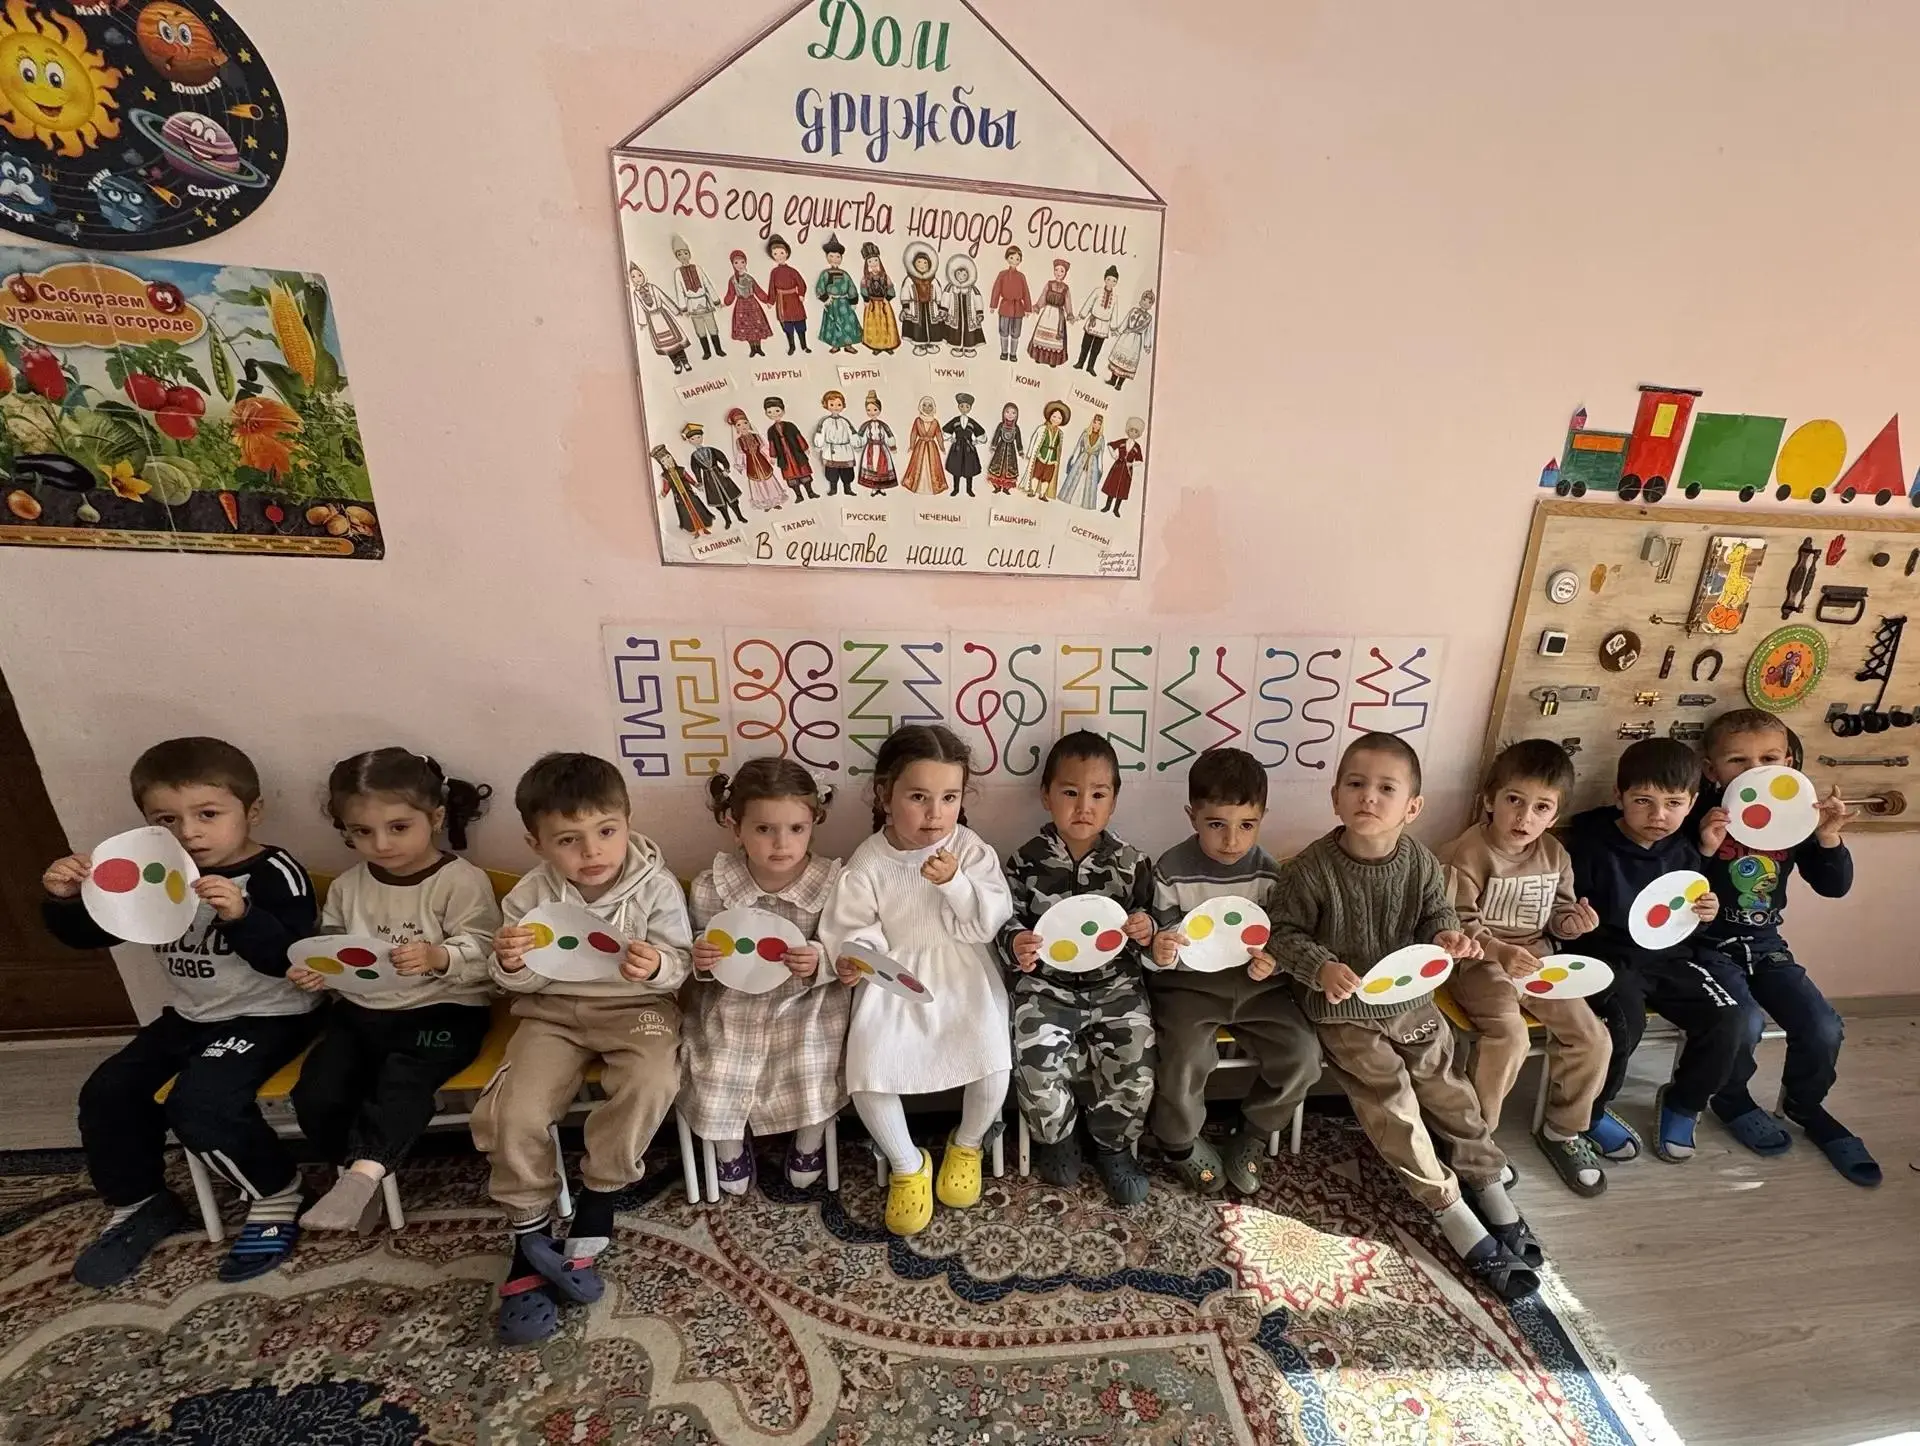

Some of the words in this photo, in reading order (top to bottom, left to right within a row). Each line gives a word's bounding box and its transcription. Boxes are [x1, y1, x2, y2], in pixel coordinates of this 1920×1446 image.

[807, 0, 951, 72] Дом
[170, 76, 222, 95] Юпитер
[795, 85, 1021, 163] дружбы
[187, 183, 240, 201] Сатурн
[618, 163, 720, 219] 2026
[724, 188, 774, 240] год
[783, 191, 895, 245] единства
[906, 204, 1013, 259] народов
[38, 283, 145, 308] Собираем
[6, 306, 78, 324] урожай
[84, 313, 108, 326] на
[113, 315, 195, 333] огороде
[755, 369, 802, 382] УДМУРТЫ
[843, 369, 881, 381] БУРЯТЫ
[934, 367, 966, 378] ЧУКЧИ
[1015, 374, 1041, 389] КОМИ
[682, 378, 728, 400] МАРИЙЦЫ
[1074, 388, 1110, 411] ЧУВАШИ
[781, 517, 817, 533] ТАТАРЫ
[846, 512, 888, 522] РУССКИЕ
[919, 512, 962, 523] ЧЕЧЕНЦЫ
[993, 513, 1038, 527] БАШКИРЫ
[697, 535, 742, 556] КАЛМЫКИ
[1071, 525, 1111, 546] ОСЕТИНЫ
[756, 531, 774, 560] В
[786, 532, 889, 567] единстве
[906, 544, 968, 566] наша
[167, 957, 215, 979] 1986
